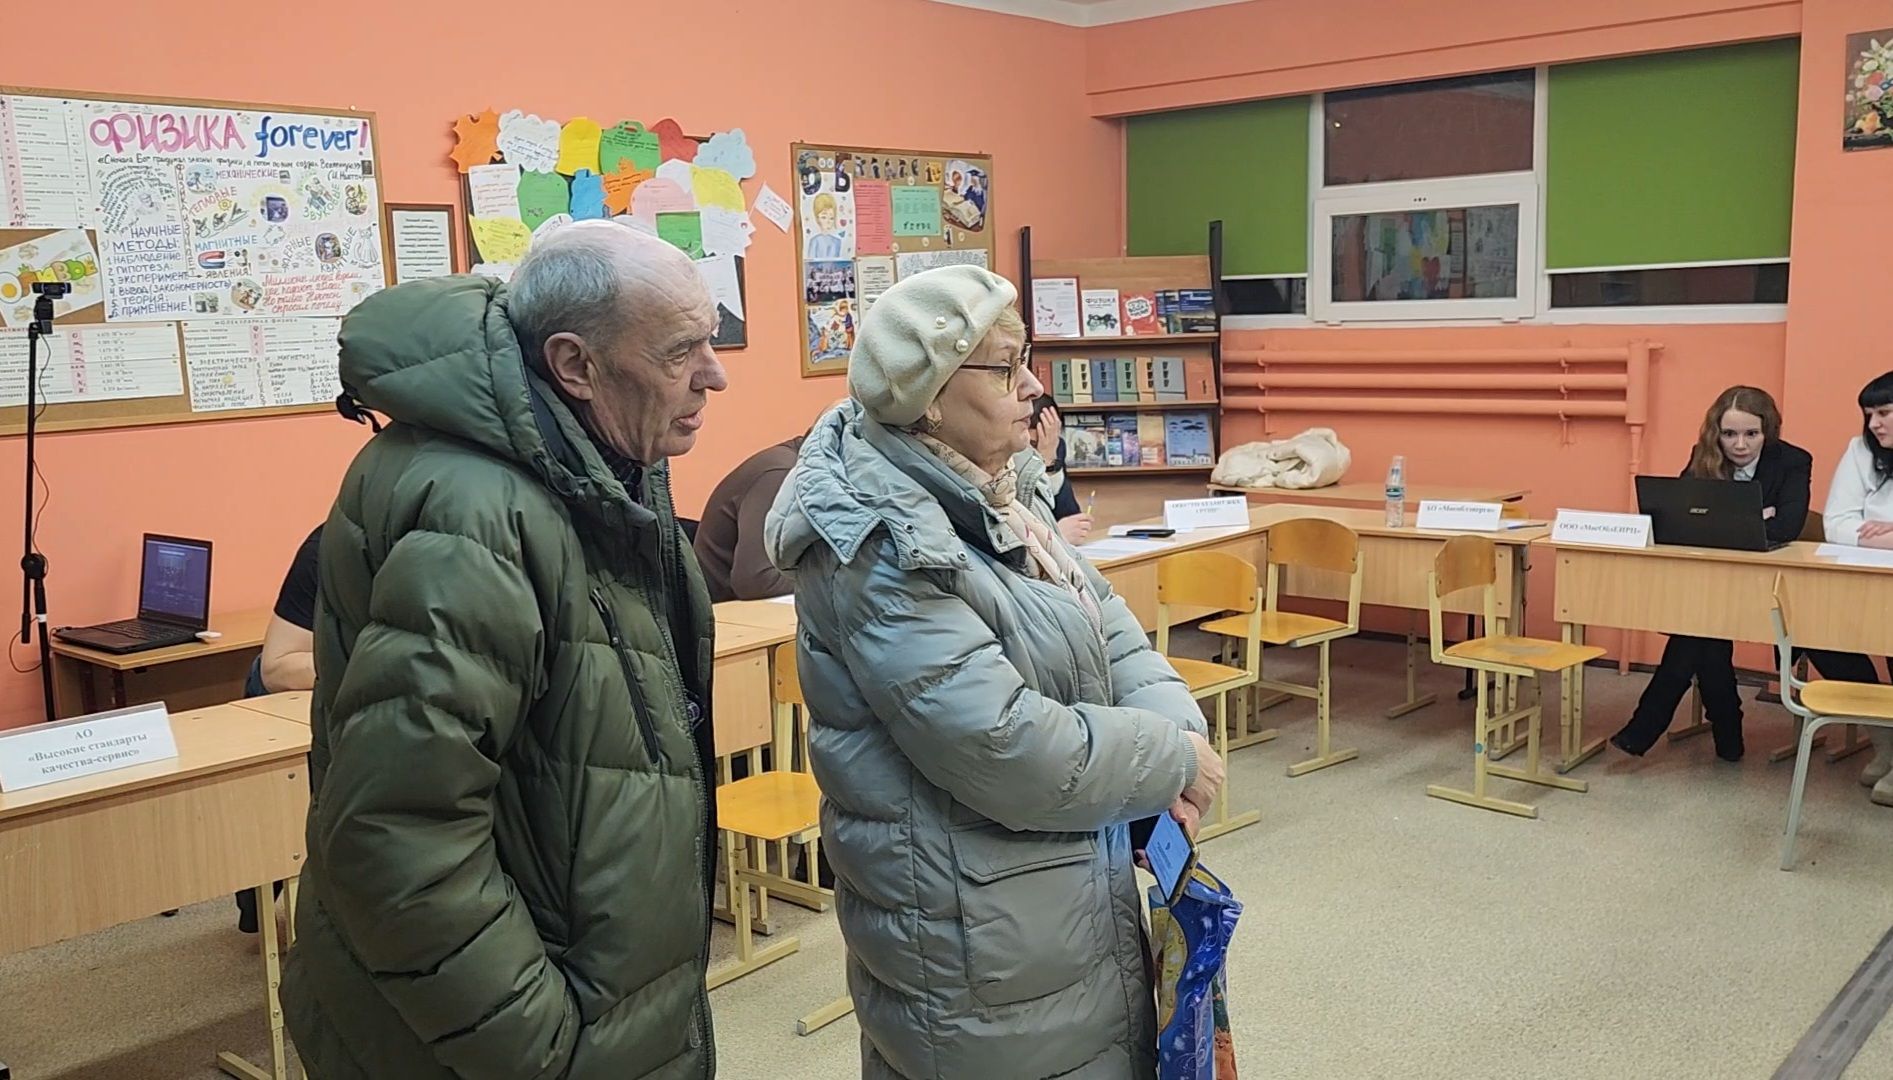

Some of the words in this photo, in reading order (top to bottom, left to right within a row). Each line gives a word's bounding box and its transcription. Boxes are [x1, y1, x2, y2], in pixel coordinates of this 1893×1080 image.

[90, 113, 246, 153] ФИЗИКА
[216, 169, 278, 180] МЕХАНИЧЕСКИЕ
[188, 186, 238, 216] ТЕПЛОВЫЕ
[130, 224, 182, 239] НАУЧНЫЕ
[194, 234, 258, 251] МАГНИТНЫЕ
[75, 728, 93, 740] АО
[28, 745, 87, 762] «Высокие
[88, 733, 148, 752] стандарты
[41, 748, 140, 774] качества-сервис»
